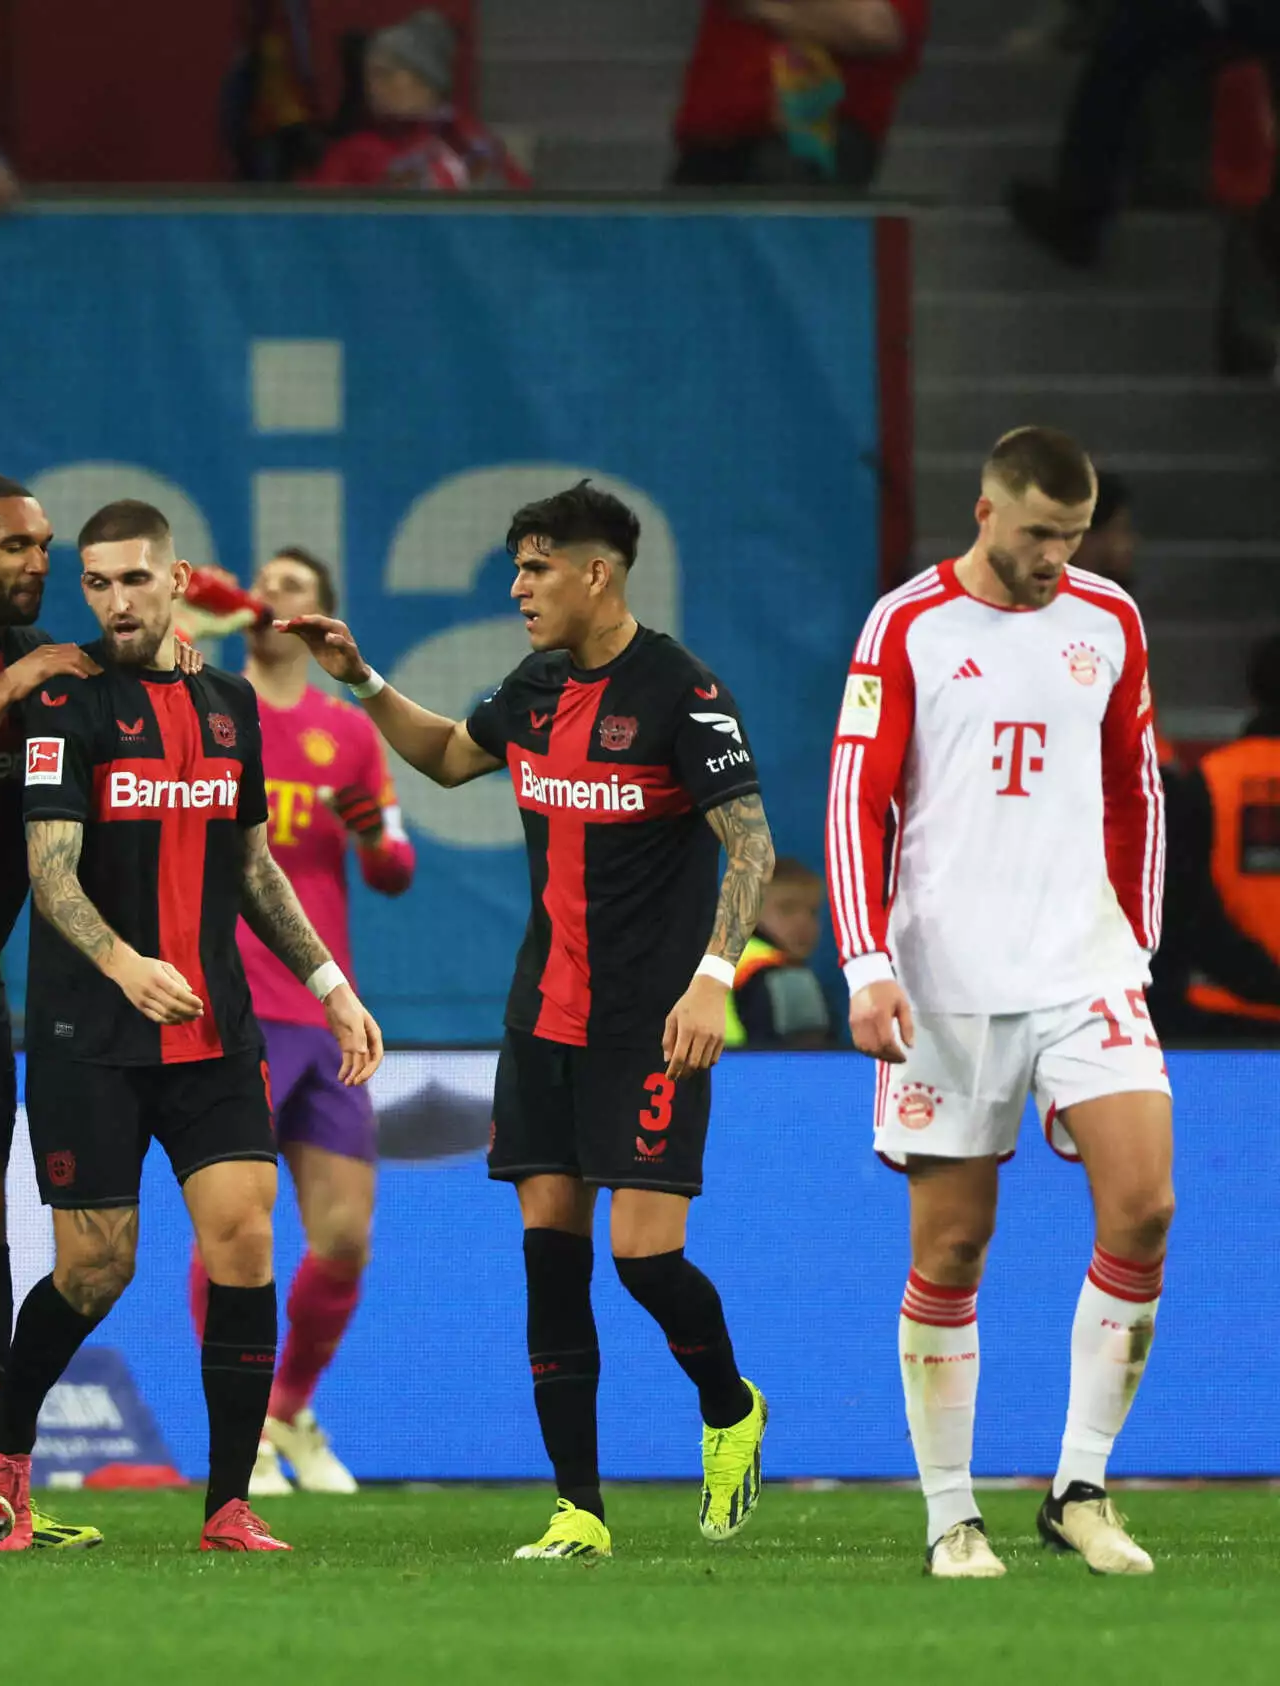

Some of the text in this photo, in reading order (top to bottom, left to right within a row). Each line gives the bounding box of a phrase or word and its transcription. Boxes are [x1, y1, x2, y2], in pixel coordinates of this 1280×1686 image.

[520, 760, 646, 812] Barmenia
[992, 721, 1047, 797] T
[639, 1071, 676, 1132] 3
